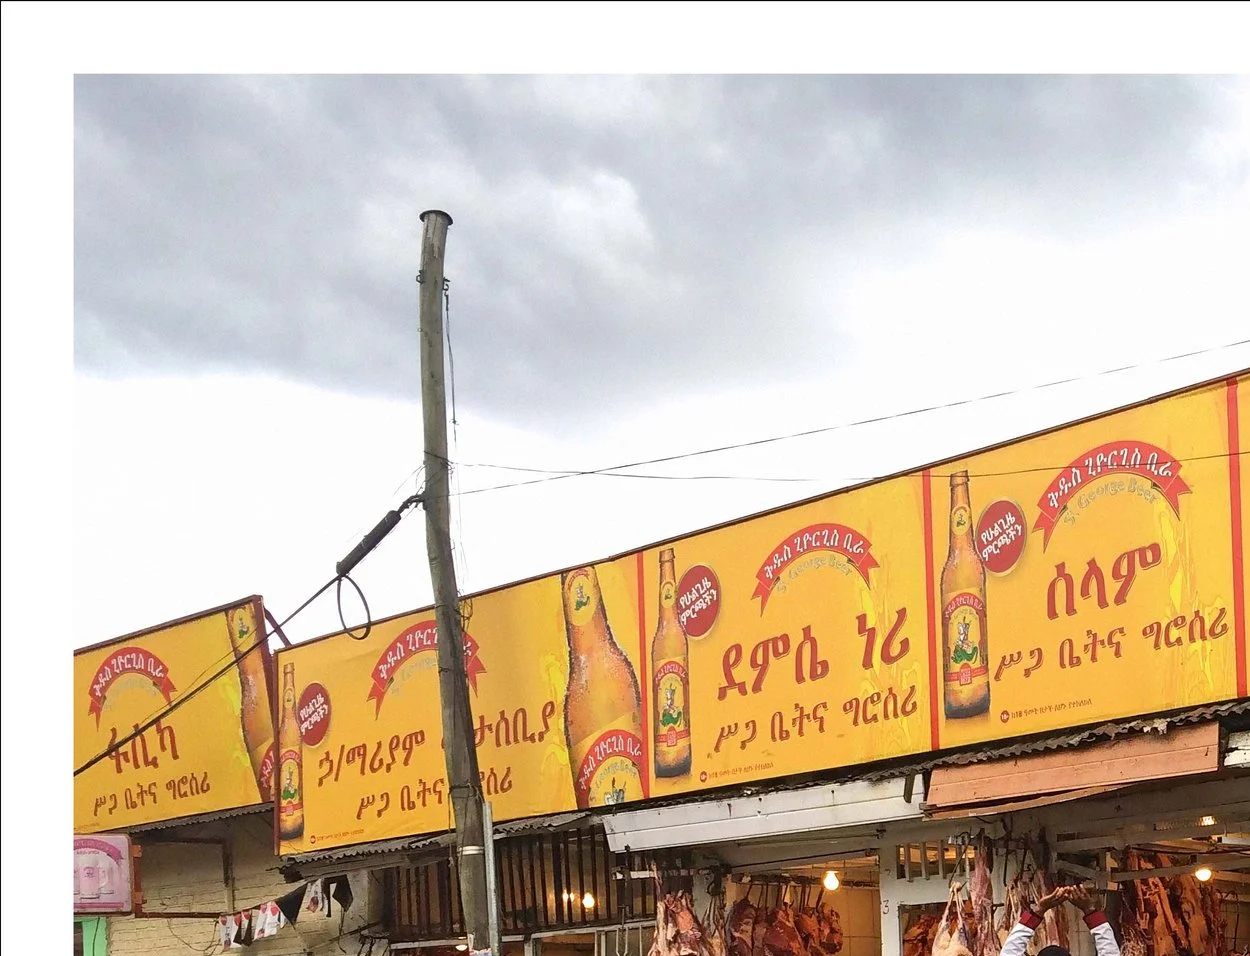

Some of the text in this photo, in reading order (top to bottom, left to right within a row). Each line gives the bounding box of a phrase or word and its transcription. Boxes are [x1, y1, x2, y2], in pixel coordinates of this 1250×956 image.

[1048, 448, 1173, 509] ቅዱስ ጊዮርጊስ ቢራ
[794, 529, 839, 554] ጊዮርጊስ
[843, 533, 865, 555] ቢራ
[1046, 542, 1162, 620] ሰላም
[406, 627, 439, 651] ጊዮር
[717, 625, 830, 701] ደምሴ
[994, 607, 1230, 682] ሥጋ ቤትና ግሮሰሪ
[441, 701, 556, 749] ታሰቢያ
[714, 684, 918, 753] ሥጋ ቤትና ግሮሰሪ
[94, 771, 211, 816] ሥጋ ቤትና ግሮሰሪ
[356, 766, 513, 820] ሥጋ ቤትና ሰሪ
